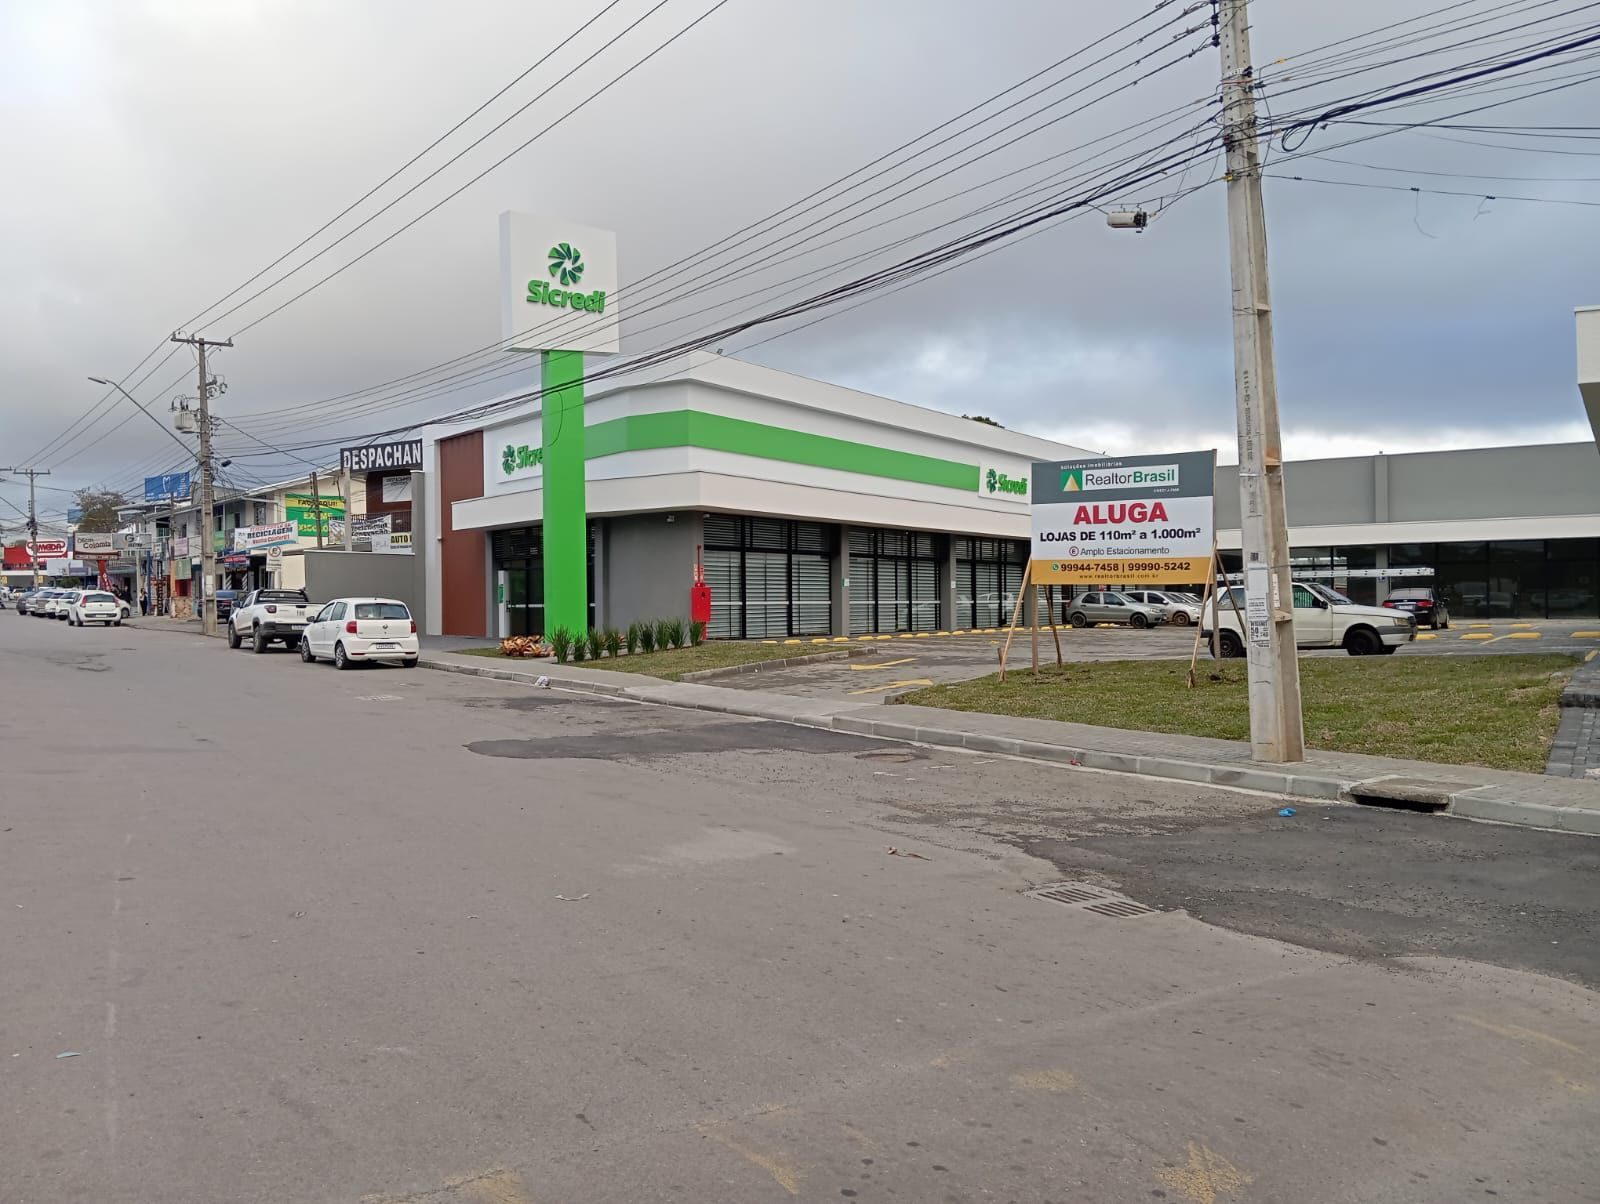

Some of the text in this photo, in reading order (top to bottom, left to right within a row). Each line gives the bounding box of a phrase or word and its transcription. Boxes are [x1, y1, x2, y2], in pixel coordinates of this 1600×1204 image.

[526, 279, 606, 314] Sicredi
[343, 442, 421, 470] DESPACHAN
[516, 445, 543, 469] Sicre
[997, 473, 1028, 496] Sicredi
[1073, 502, 1169, 525] ALUGA
[247, 526, 293, 539] RECICLAGEM
[390, 534, 409, 544] AUTO
[1040, 527, 1201, 542] LOJAS DE 110m² a 1.000m²
[1080, 547, 1105, 557] Amplo
[1106, 546, 1170, 555] Estacionamento
[1061, 562, 1191, 572] 99944-7458 99990-5242
